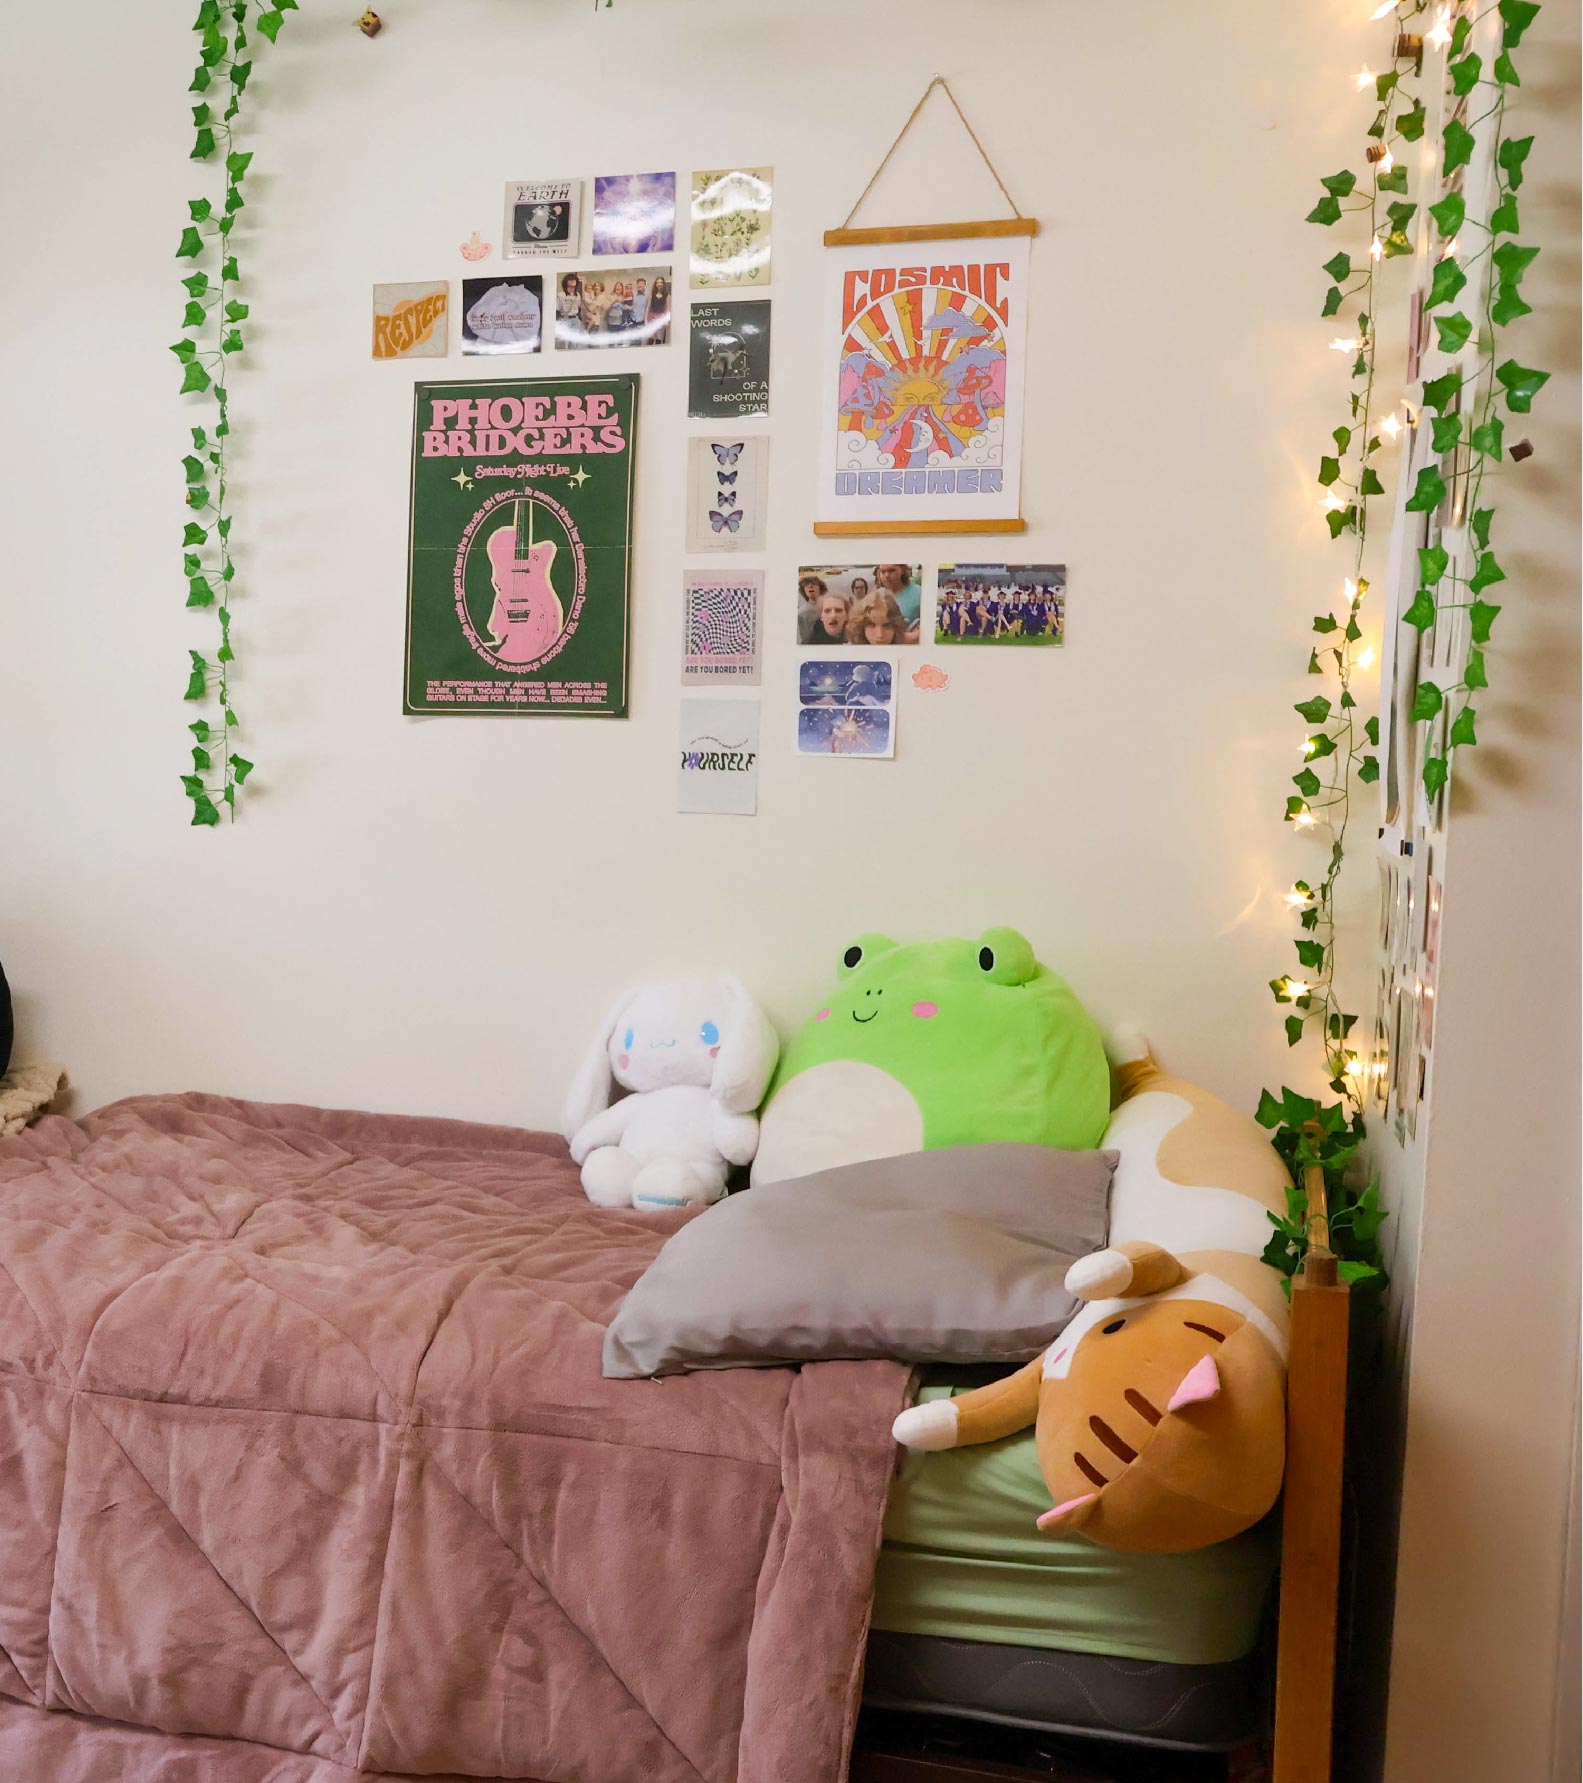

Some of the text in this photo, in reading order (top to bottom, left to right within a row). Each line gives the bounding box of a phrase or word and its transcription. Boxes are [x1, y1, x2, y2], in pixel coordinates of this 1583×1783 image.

[518, 189, 570, 201] EARTH
[842, 263, 1010, 335] COSMIC
[690, 308, 719, 317] LAST
[372, 294, 447, 358] RESPECT
[690, 318, 732, 328] WORDS
[742, 381, 768, 391] OF A
[712, 392, 768, 402] SHOOTING
[430, 394, 619, 431] PHOEBE
[738, 403, 768, 412] STAR
[422, 426, 626, 458] BRIDGERS
[474, 463, 570, 479] Saturday Night Live
[835, 468, 1004, 496] DREAMER
[533, 490, 561, 511] seems
[464, 508, 486, 536] Studio
[570, 526, 581, 542] her
[456, 536, 469, 554] the
[454, 577, 464, 600] egos
[572, 596, 586, 620] Dano
[476, 647, 496, 666] more
[685, 666, 754, 674] ARE YOU BORED YET?
[456, 688, 474, 696] EVEN
[478, 688, 506, 696] THOUGH
[510, 688, 524, 696] MEN
[528, 688, 546, 696] HAVE
[550, 688, 568, 696] BEEN
[456, 695, 466, 703] ON
[490, 695, 505, 703] FOR
[506, 695, 528, 703] YEARS
[552, 695, 582, 703] DECADES
